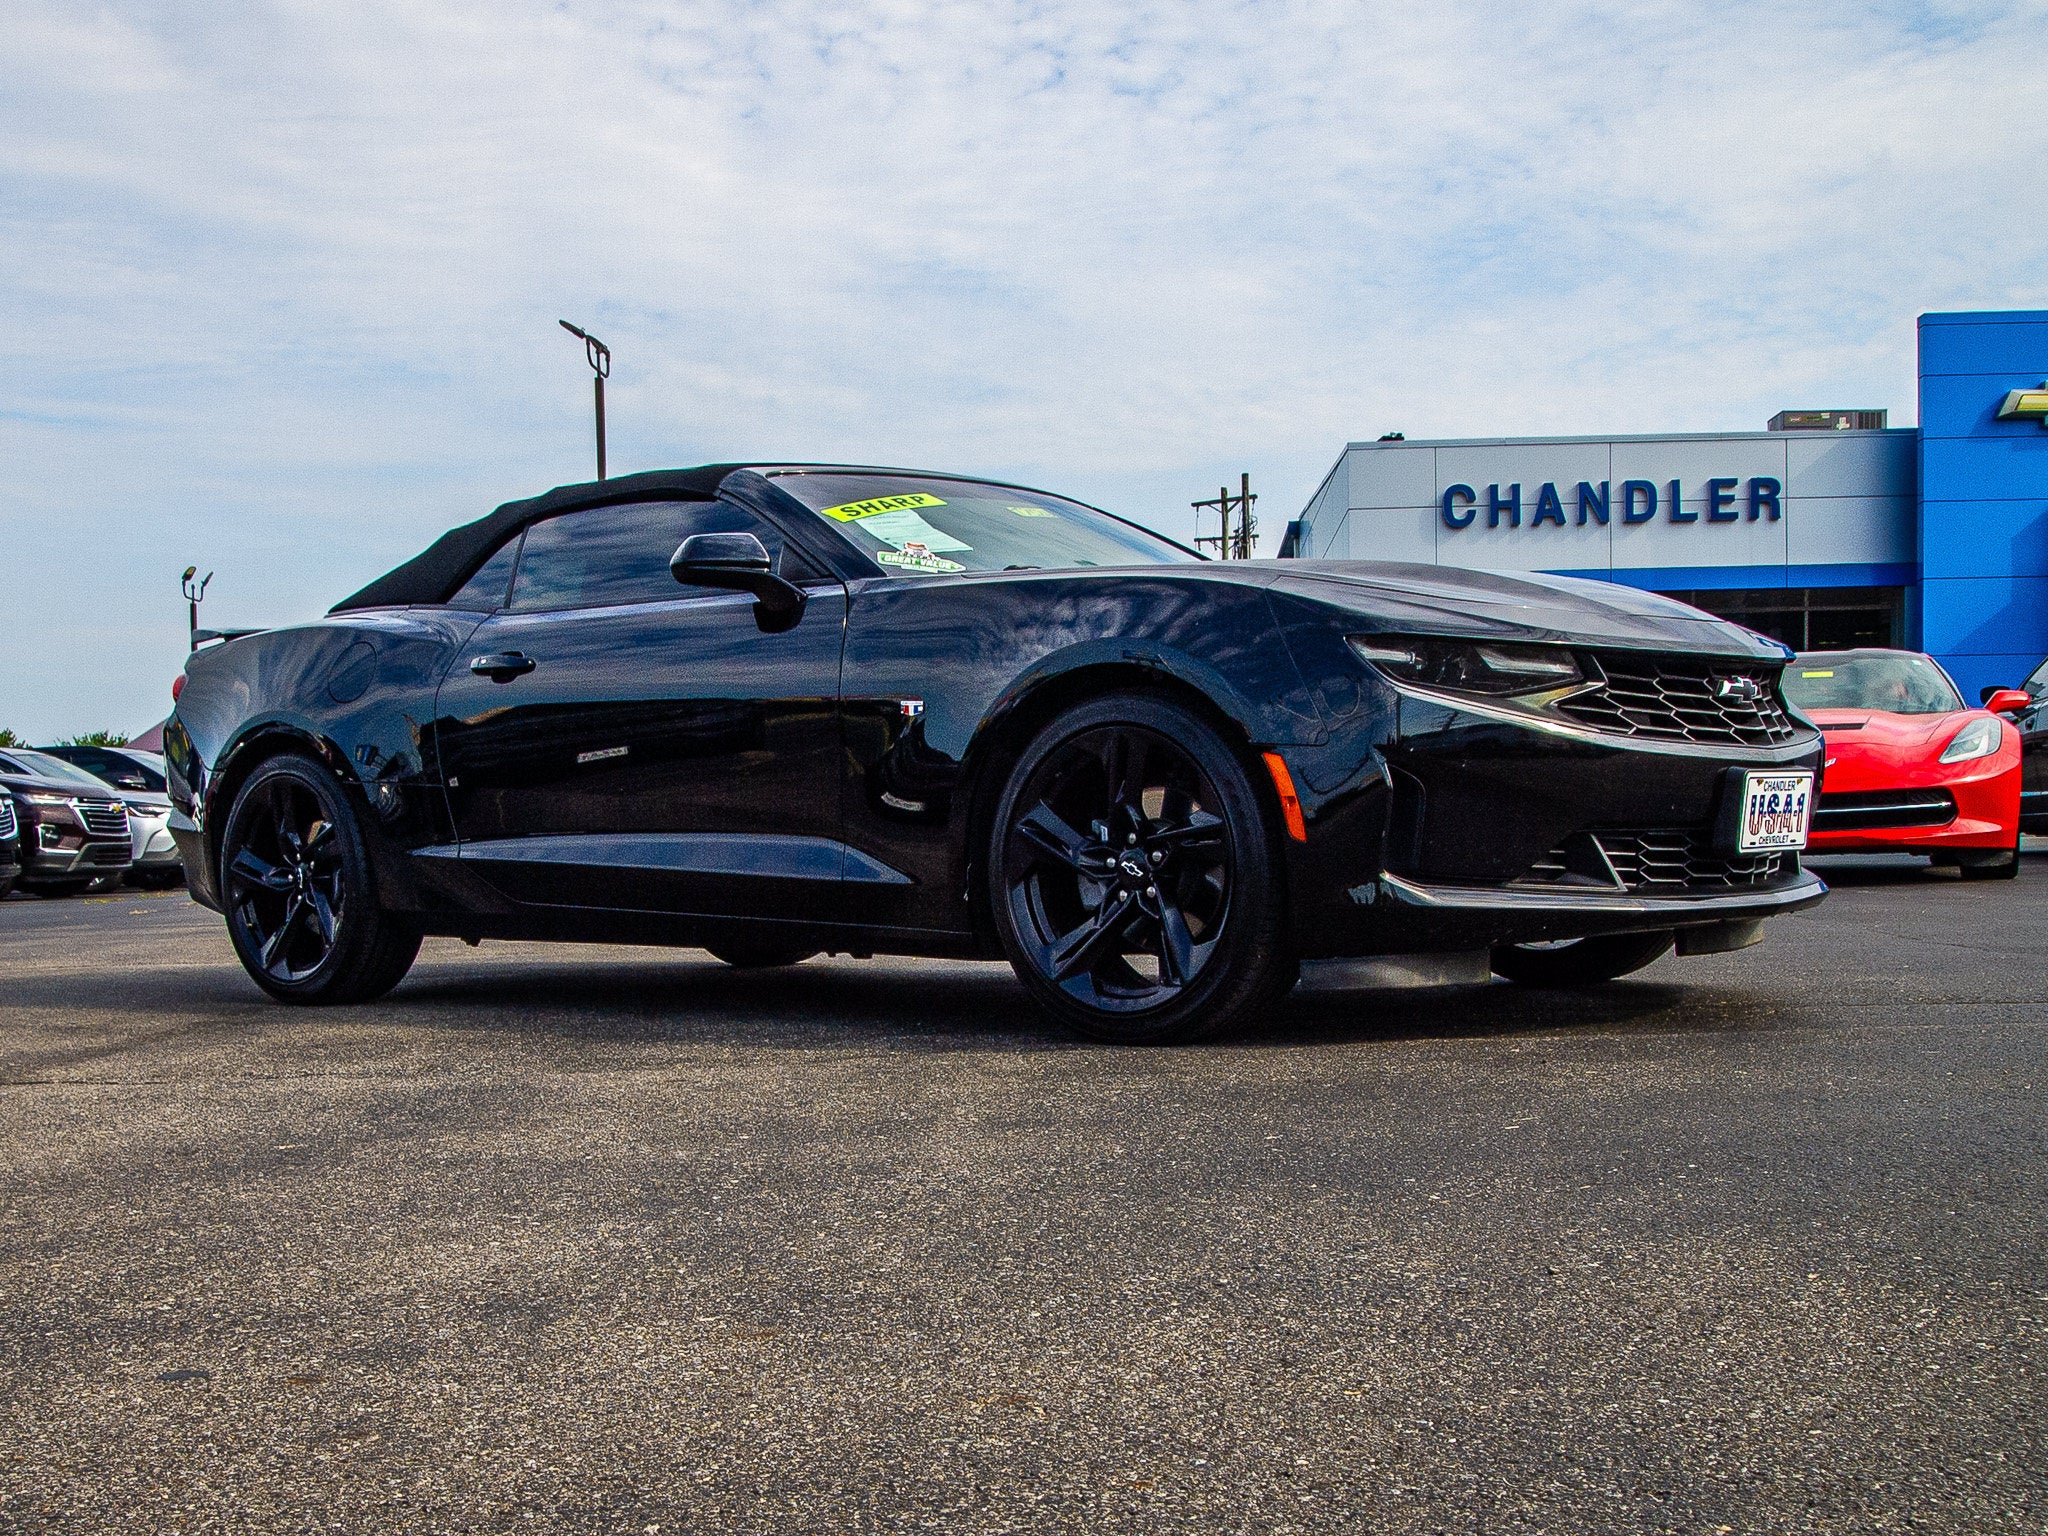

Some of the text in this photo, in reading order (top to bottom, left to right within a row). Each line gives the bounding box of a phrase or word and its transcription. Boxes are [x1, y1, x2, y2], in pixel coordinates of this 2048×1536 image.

[840, 495, 925, 517] SHARP
[1442, 477, 1782, 528] CHANDLER
[1763, 780, 1796, 792] CHANDLER
[1758, 834, 1789, 845] CHEVROLET
